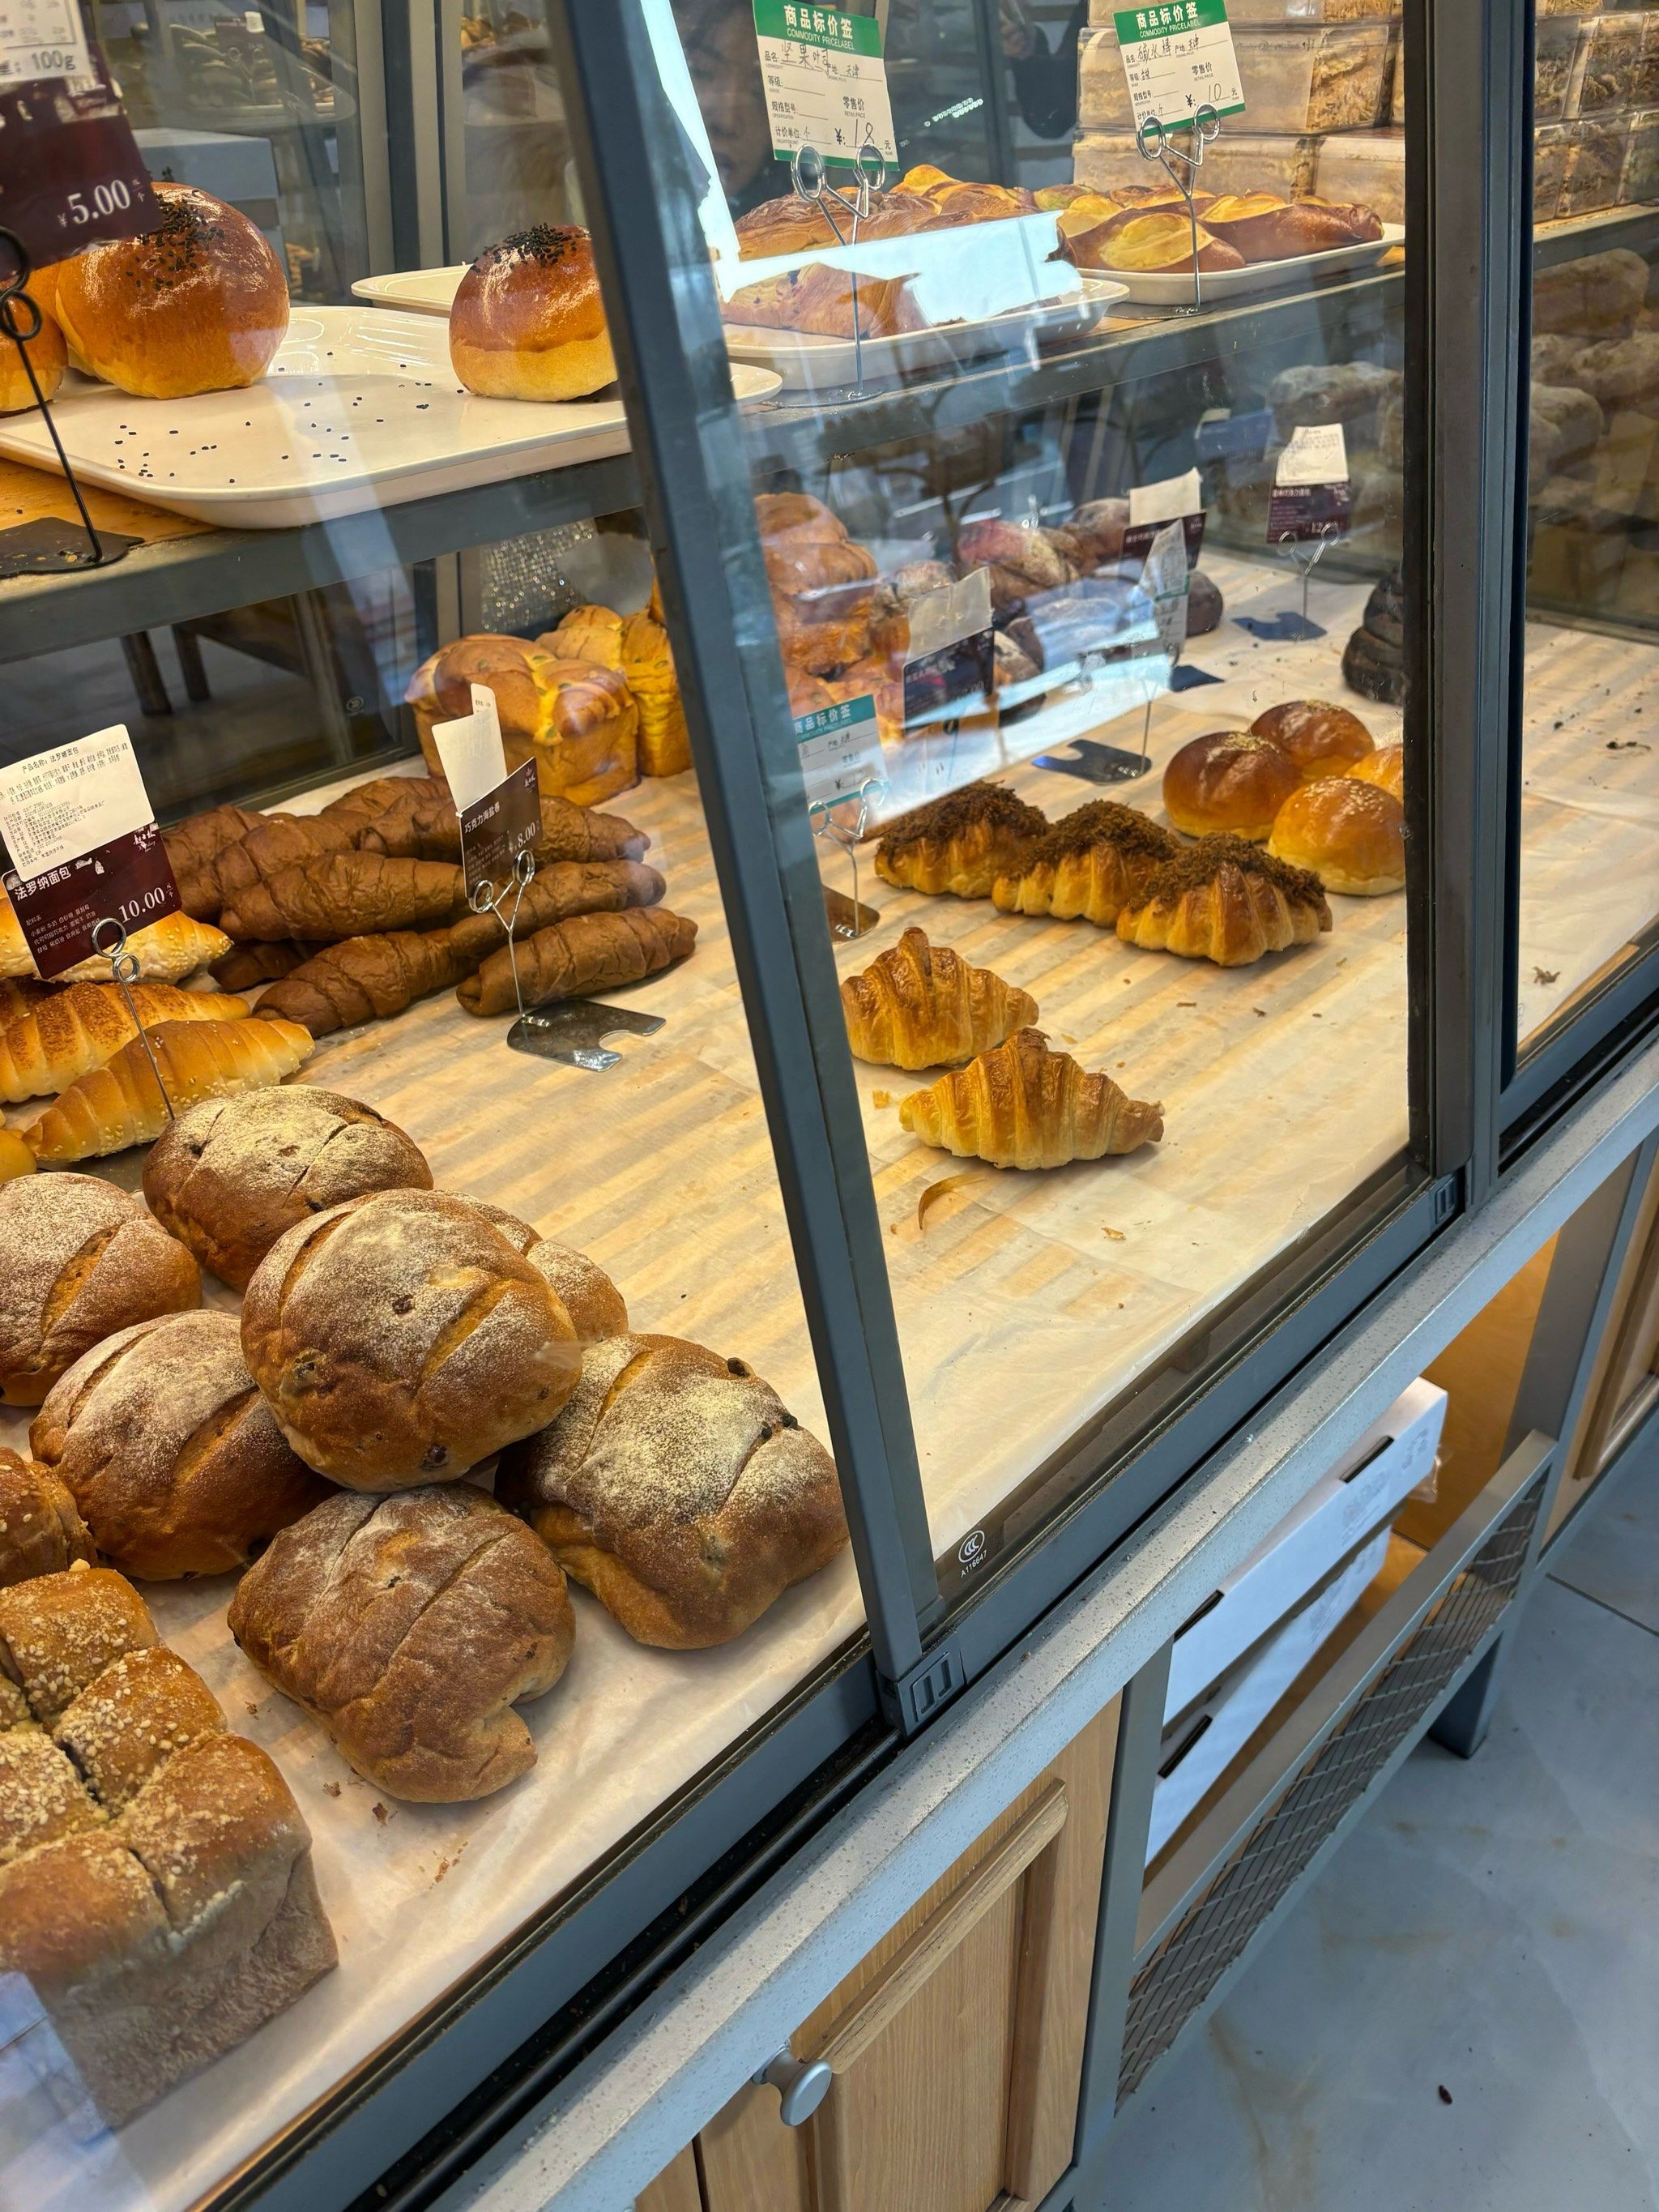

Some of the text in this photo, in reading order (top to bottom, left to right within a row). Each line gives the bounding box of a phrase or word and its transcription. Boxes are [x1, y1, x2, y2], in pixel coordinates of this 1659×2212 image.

[783, 4, 853, 40] 商品标价签
[1136, 2, 1199, 30] 商品标价签
[1139, 19, 1201, 38] COMMODITY PRICELABEL
[787, 28, 855, 50] COMMODITY PRICELABEL
[32, 50, 76, 71] 100g
[1192, 62, 1213, 75] 零售价
[843, 96, 864, 111] 零售价
[1209, 83, 1222, 102] 10
[855, 118, 875, 148] 18
[885, 139, 891, 150] 元
[794, 703, 851, 734] 商品标价签
[15, 866, 71, 901] 法罗纳面包
[118, 887, 165, 923] 10.00
